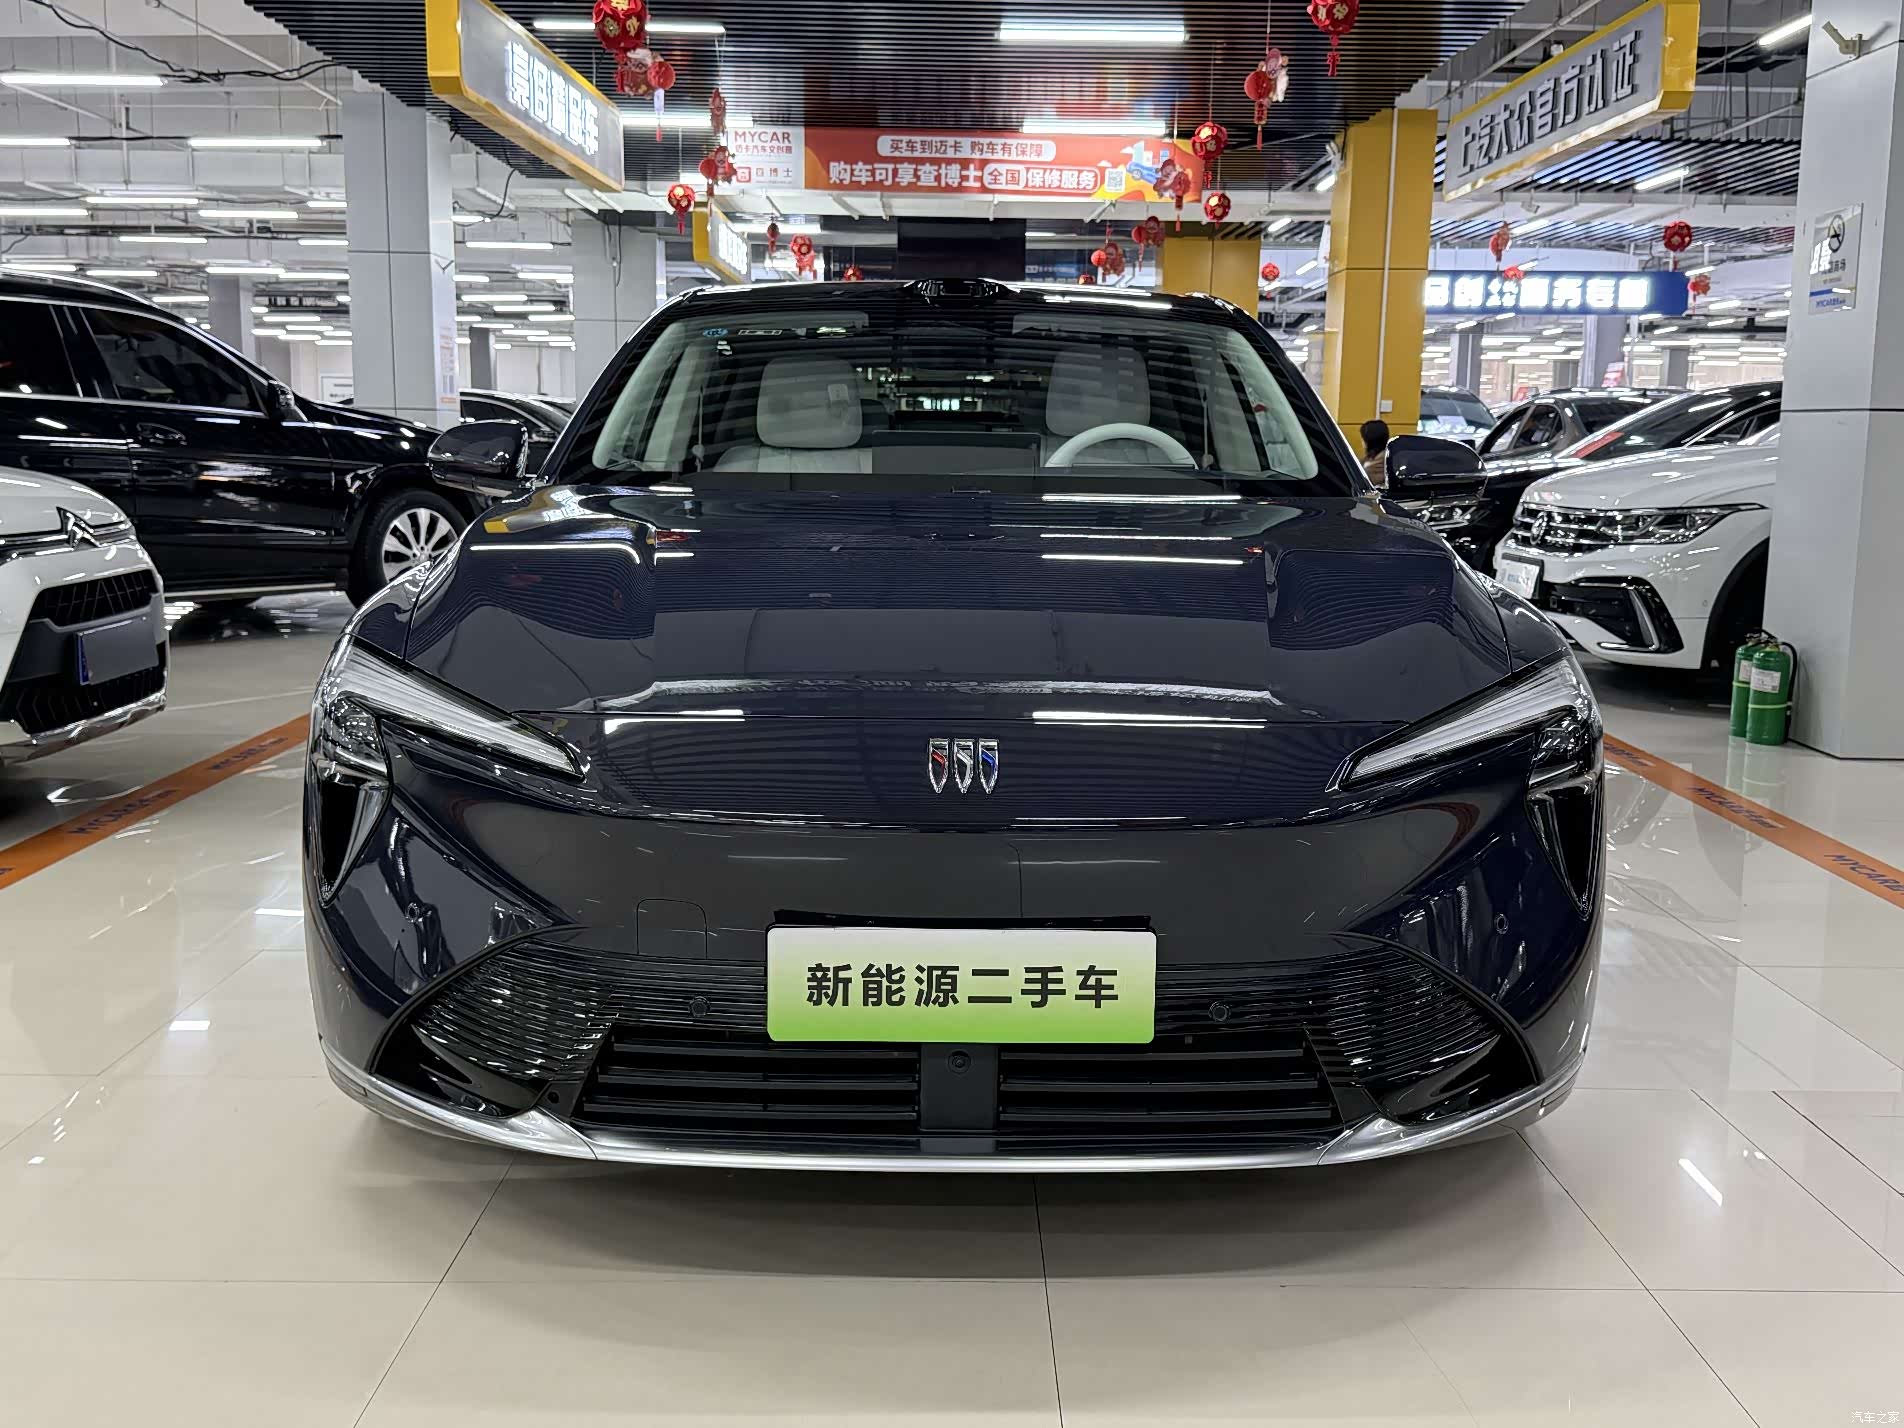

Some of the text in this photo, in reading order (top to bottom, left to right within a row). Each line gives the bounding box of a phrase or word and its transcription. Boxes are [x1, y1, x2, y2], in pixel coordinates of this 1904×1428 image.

[1459, 31, 1642, 177] 上汽大众官方认证
[734, 131, 792, 144] MYCAR
[889, 139, 1044, 158] 买车到迈卡 购车有保障
[806, 962, 1119, 1009] 新能源二手车
